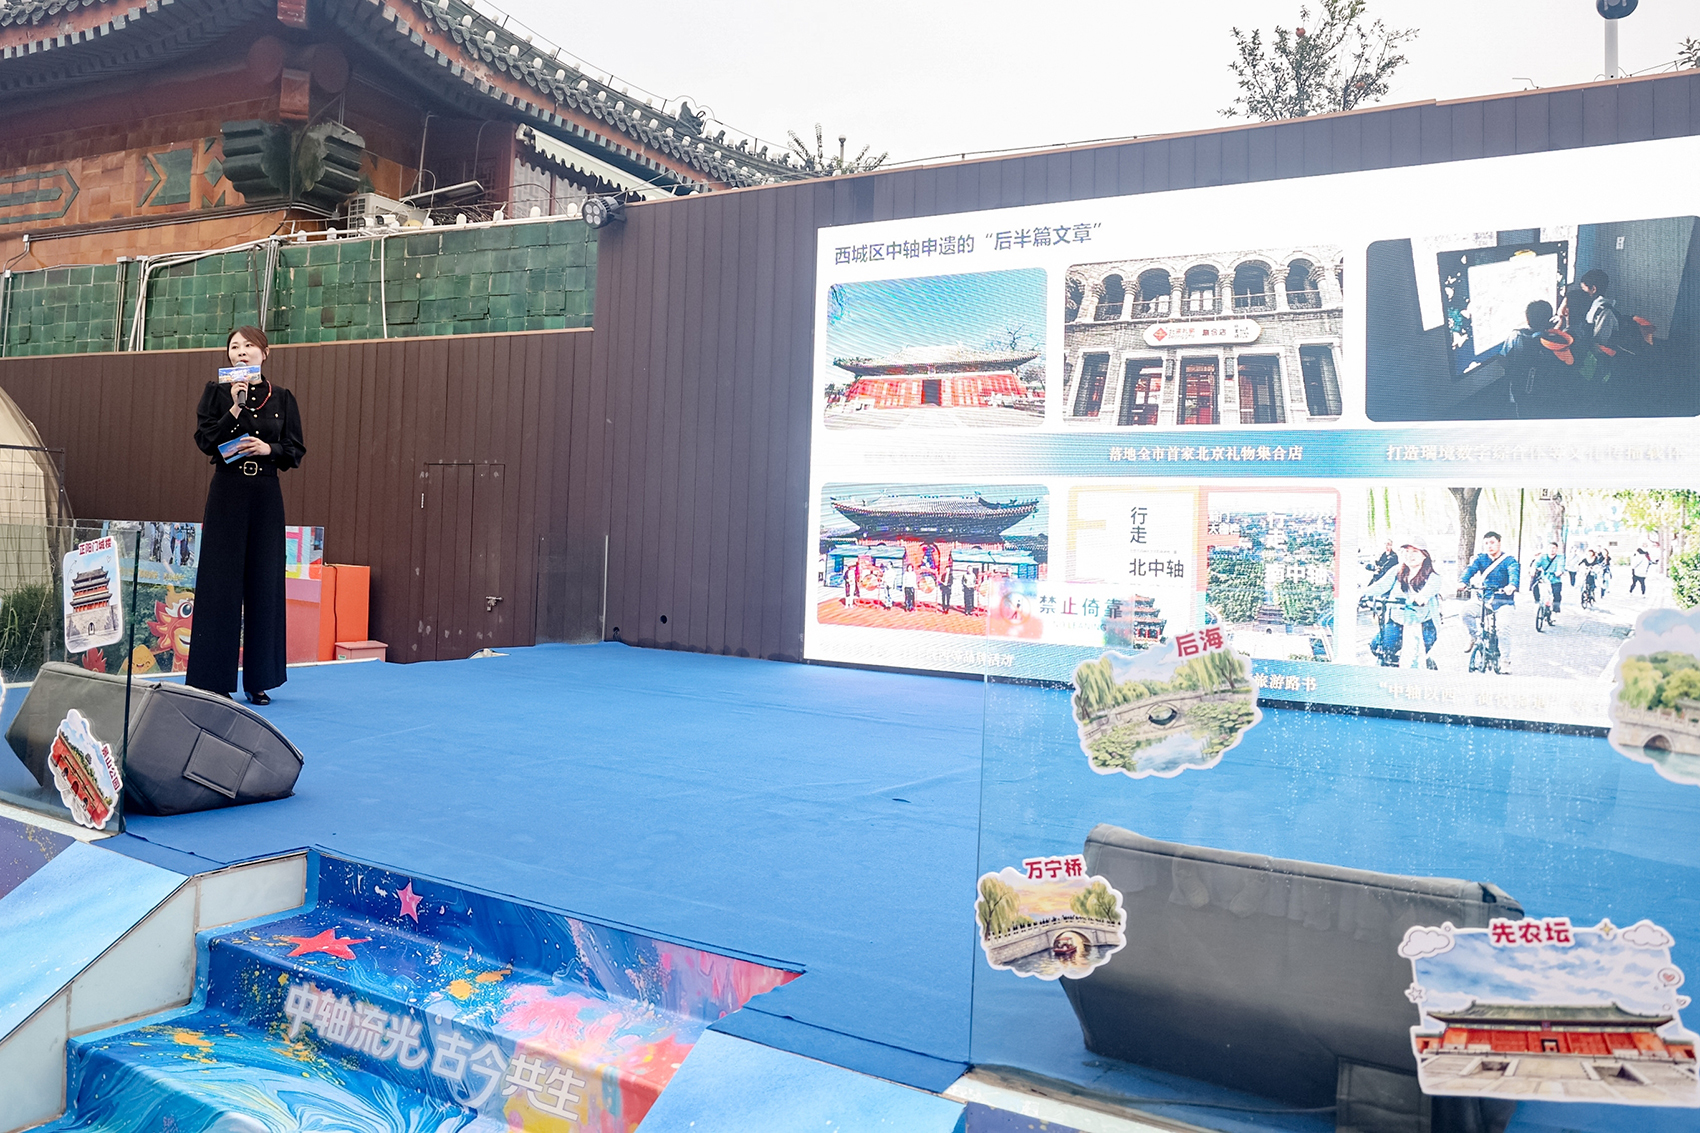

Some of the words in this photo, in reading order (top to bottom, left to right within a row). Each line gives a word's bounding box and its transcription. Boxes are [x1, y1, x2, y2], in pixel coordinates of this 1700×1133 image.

[834, 222, 1102, 265] 西城区中轴申遗的“后半篇文章”
[1108, 445, 1304, 462] 落地全市首家北京礼物集合店
[1130, 506, 1148, 544] 行走
[1129, 558, 1184, 578] 北中轴
[1039, 595, 1123, 619] 禁止倚靠
[1176, 627, 1223, 657] 后海
[1025, 858, 1082, 879] 万宁桥
[1492, 922, 1570, 943] 先农坛
[284, 983, 428, 1070] 中轴流光
[431, 1031, 586, 1121] 古今共生
